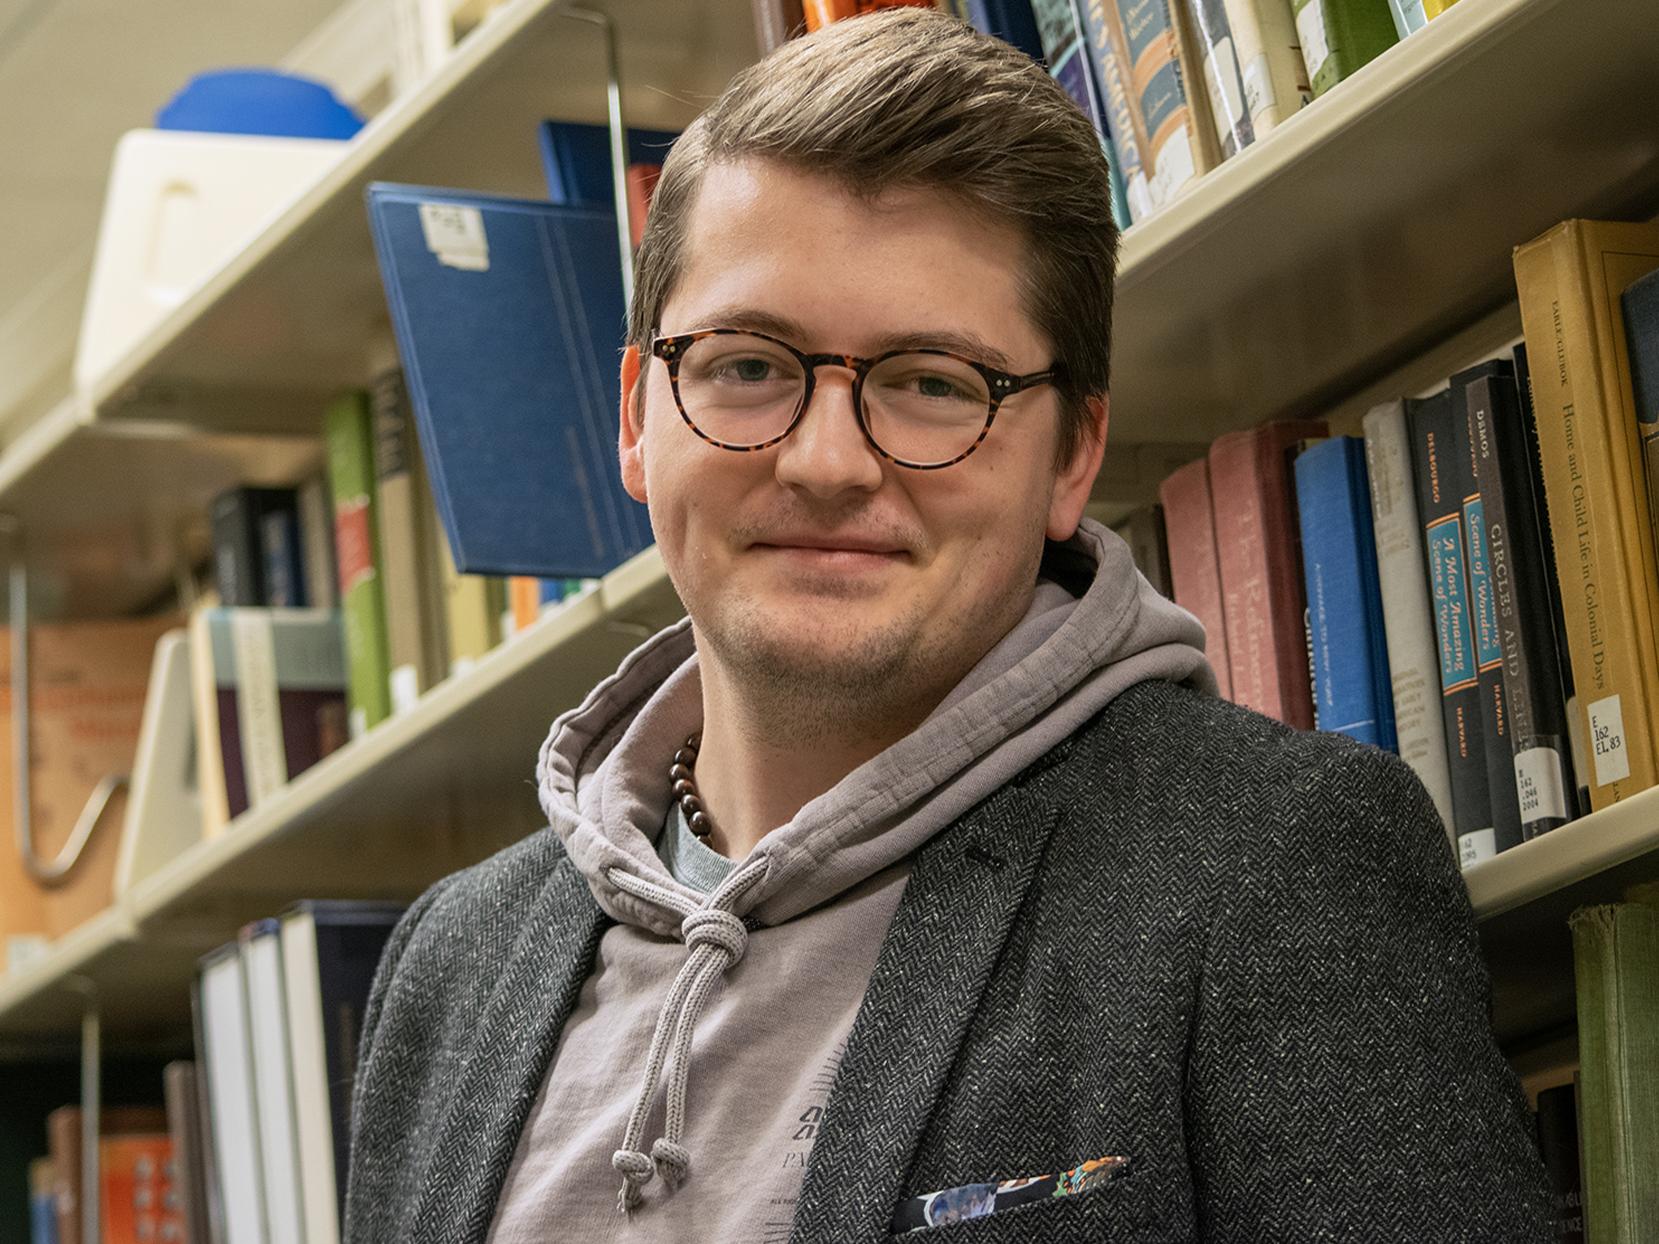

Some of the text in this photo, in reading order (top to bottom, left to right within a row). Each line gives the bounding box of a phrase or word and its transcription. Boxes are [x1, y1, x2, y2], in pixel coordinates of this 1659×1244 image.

[1477, 410, 1489, 458] DEMOS
[1427, 432, 1440, 503] DELBOURGO
[1445, 556, 1458, 596] Most
[1562, 403, 1606, 691] Home and Child Life in Colonial Days
[1432, 540, 1452, 673] Scene of Wonders
[1470, 513, 1490, 650] Scene of Wonders
[1491, 523, 1512, 617] CIRCLES
[1505, 629, 1519, 676] AND
[1450, 601, 1464, 671] Amazing
[1456, 705, 1468, 758] HARVARD
[1494, 684, 1504, 736] HARVARD
[1591, 715, 1598, 728] E
[1595, 726, 1609, 741] 162
